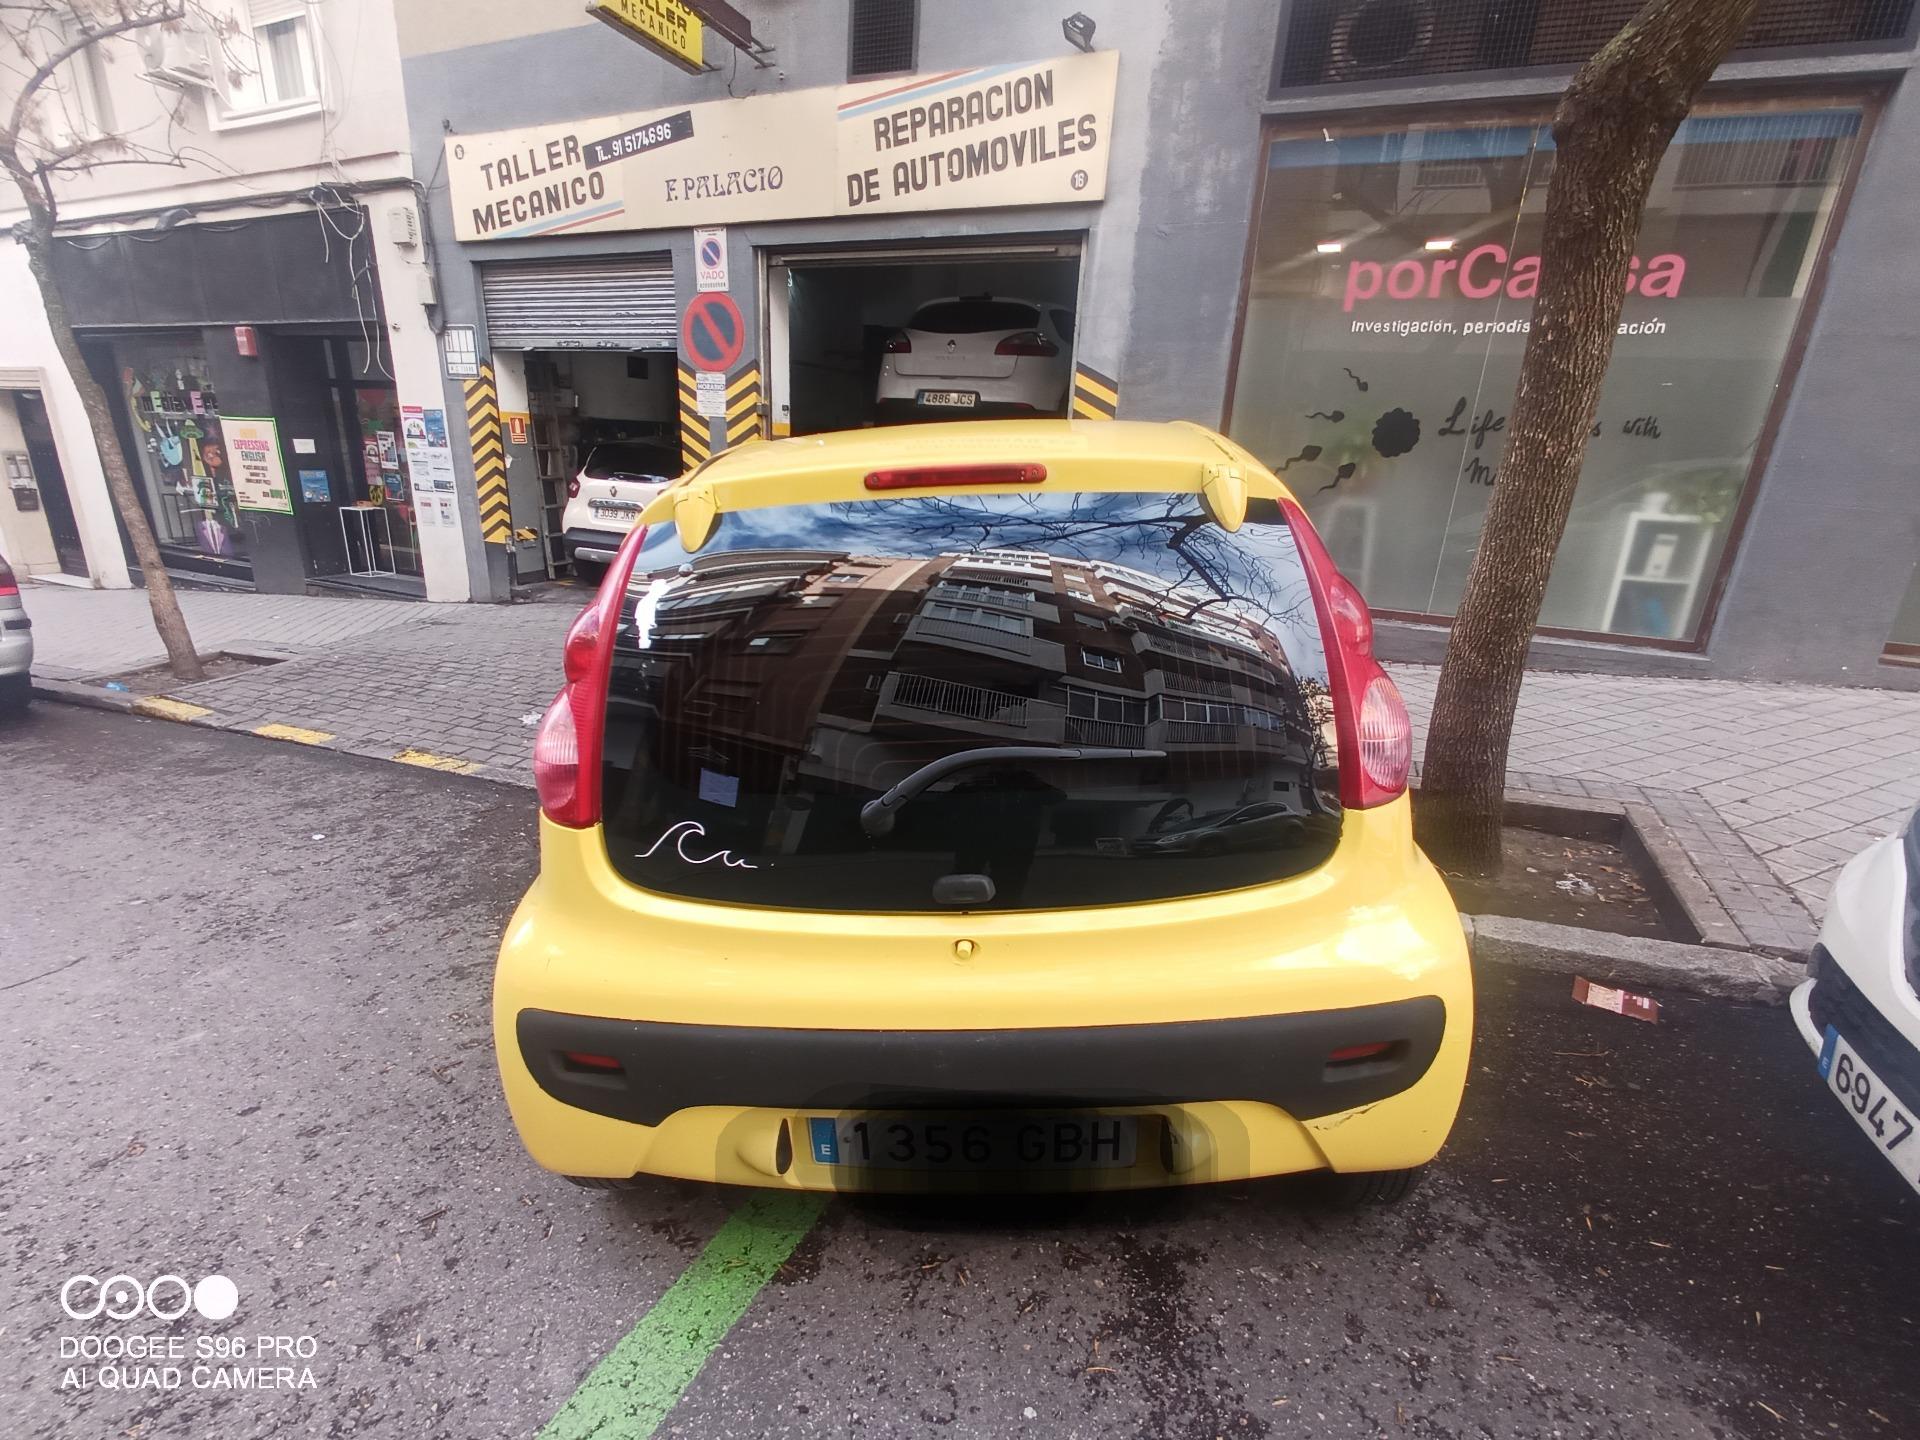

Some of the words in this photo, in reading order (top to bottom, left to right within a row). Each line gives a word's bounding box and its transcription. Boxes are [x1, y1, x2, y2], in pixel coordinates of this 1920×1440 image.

[621, 0, 686, 49] MECANICO
[640, 0, 688, 33] LLER
[873, 69, 1054, 152] REPARACION
[612, 140, 623, 156] 91
[624, 123, 672, 152] 5174696
[480, 135, 581, 191] TALLER
[847, 168, 880, 207] DE
[892, 114, 1097, 196] AUTOMOVILES
[683, 166, 784, 201] PALACIO
[1073, 173, 1086, 189] 16
[472, 171, 605, 235] MECANICO
[700, 270, 726, 280] VADO
[1343, 244, 1686, 312] porCasa
[1351, 319, 1457, 337] Investigación,
[1463, 319, 1532, 336] periodis
[1616, 317, 1666, 335] ación
[925, 392, 950, 404] 4886
[954, 393, 973, 405] JCS
[1438, 397, 1505, 449] Life
[1622, 416, 1661, 439] with
[241, 450, 267, 462] ENGLISH
[600, 507, 618, 519] 3039
[621, 509, 636, 520] JKR
[1836, 1053, 1914, 1151] 6947
[821, 1143, 831, 1155] E
[853, 1122, 992, 1163] 1356
[1017, 1120, 1121, 1163] GBH
